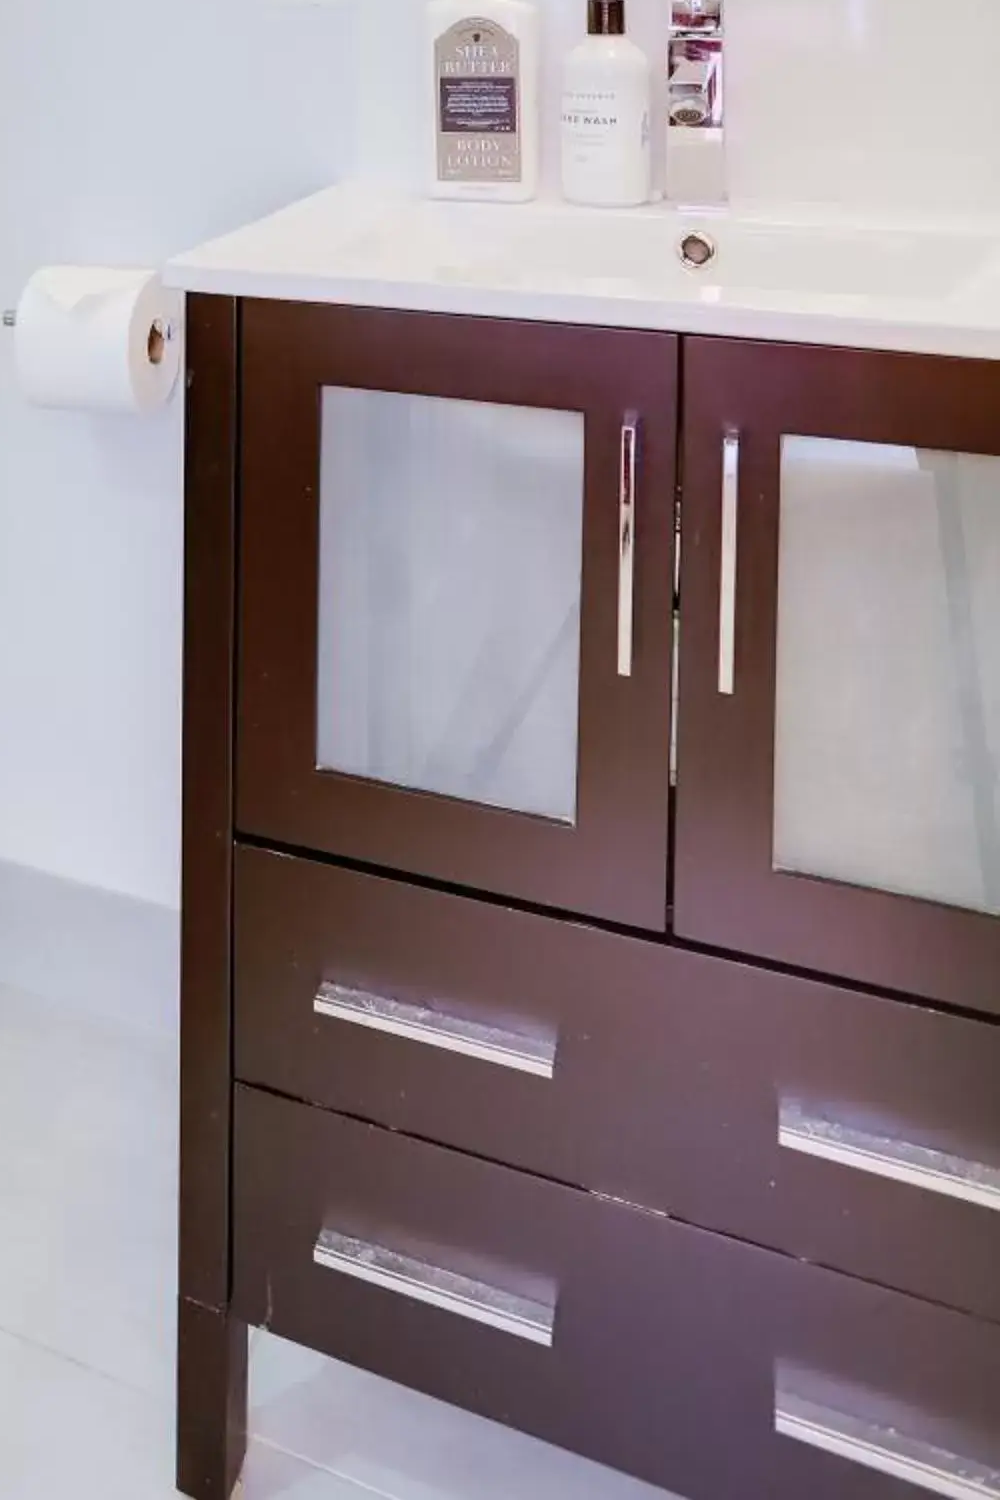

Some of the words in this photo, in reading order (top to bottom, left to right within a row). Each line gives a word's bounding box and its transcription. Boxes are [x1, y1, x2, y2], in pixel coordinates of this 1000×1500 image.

[455, 45, 499, 57] SHEA
[443, 60, 511, 73] BUTTER
[457, 139, 499, 151] BODY
[447, 155, 512, 167] LOTION
